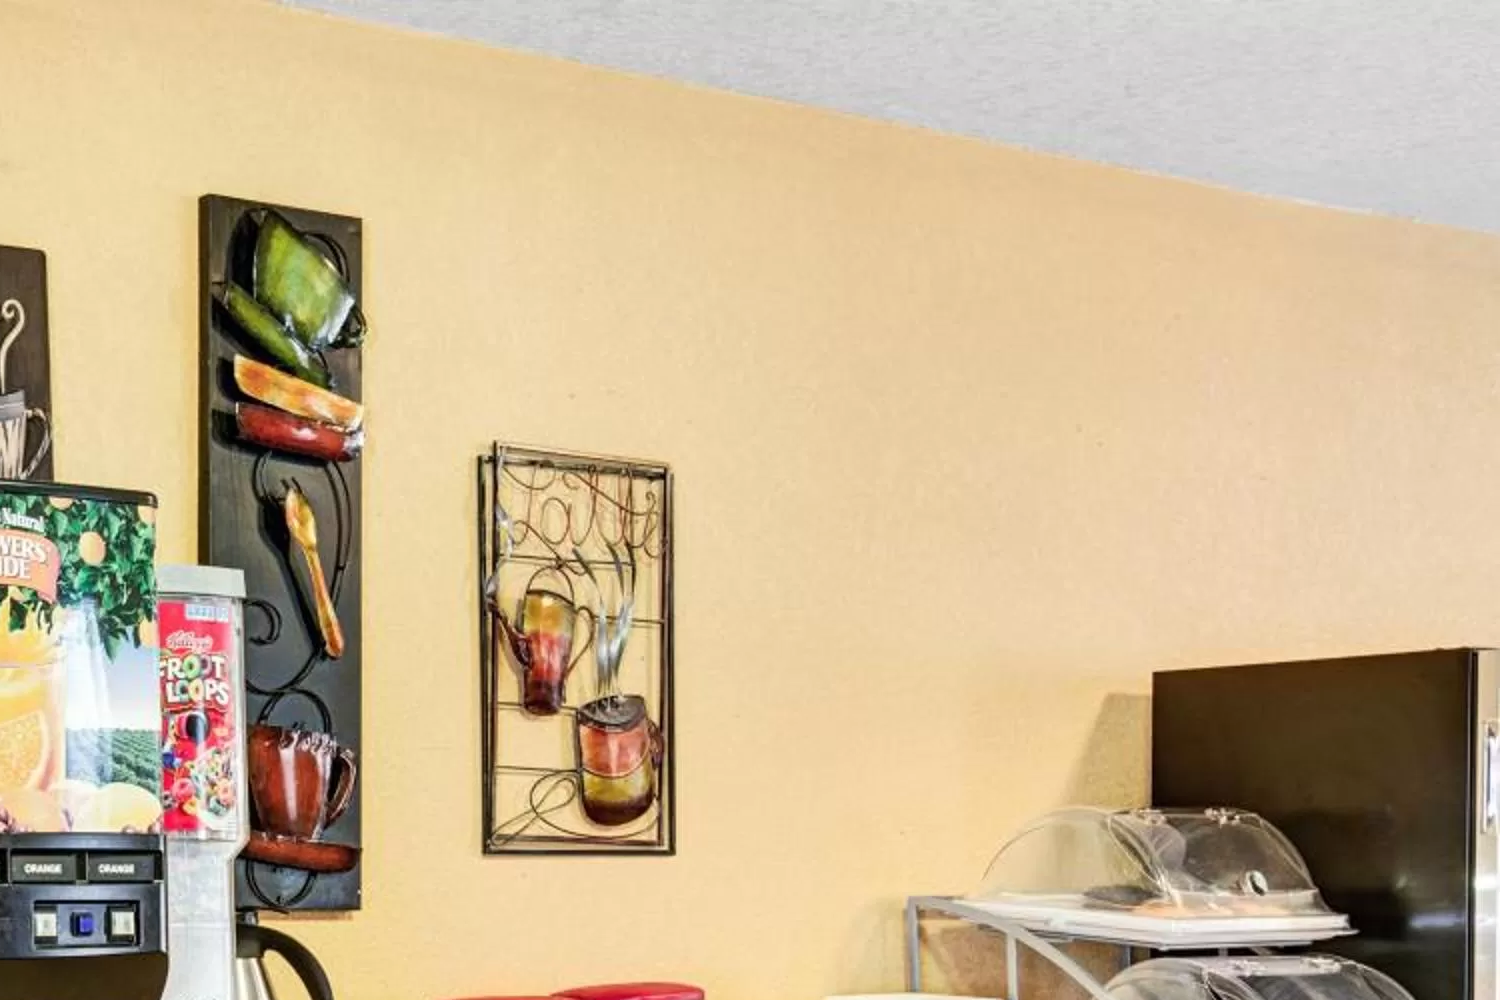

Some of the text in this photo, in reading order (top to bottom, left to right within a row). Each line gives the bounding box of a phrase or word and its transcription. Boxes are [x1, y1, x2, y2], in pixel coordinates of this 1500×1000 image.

[2, 507, 45, 533] Natural
[165, 678, 229, 705] LOOPS
[23, 863, 63, 875] ORANGE
[97, 863, 135, 875] ORANGE
